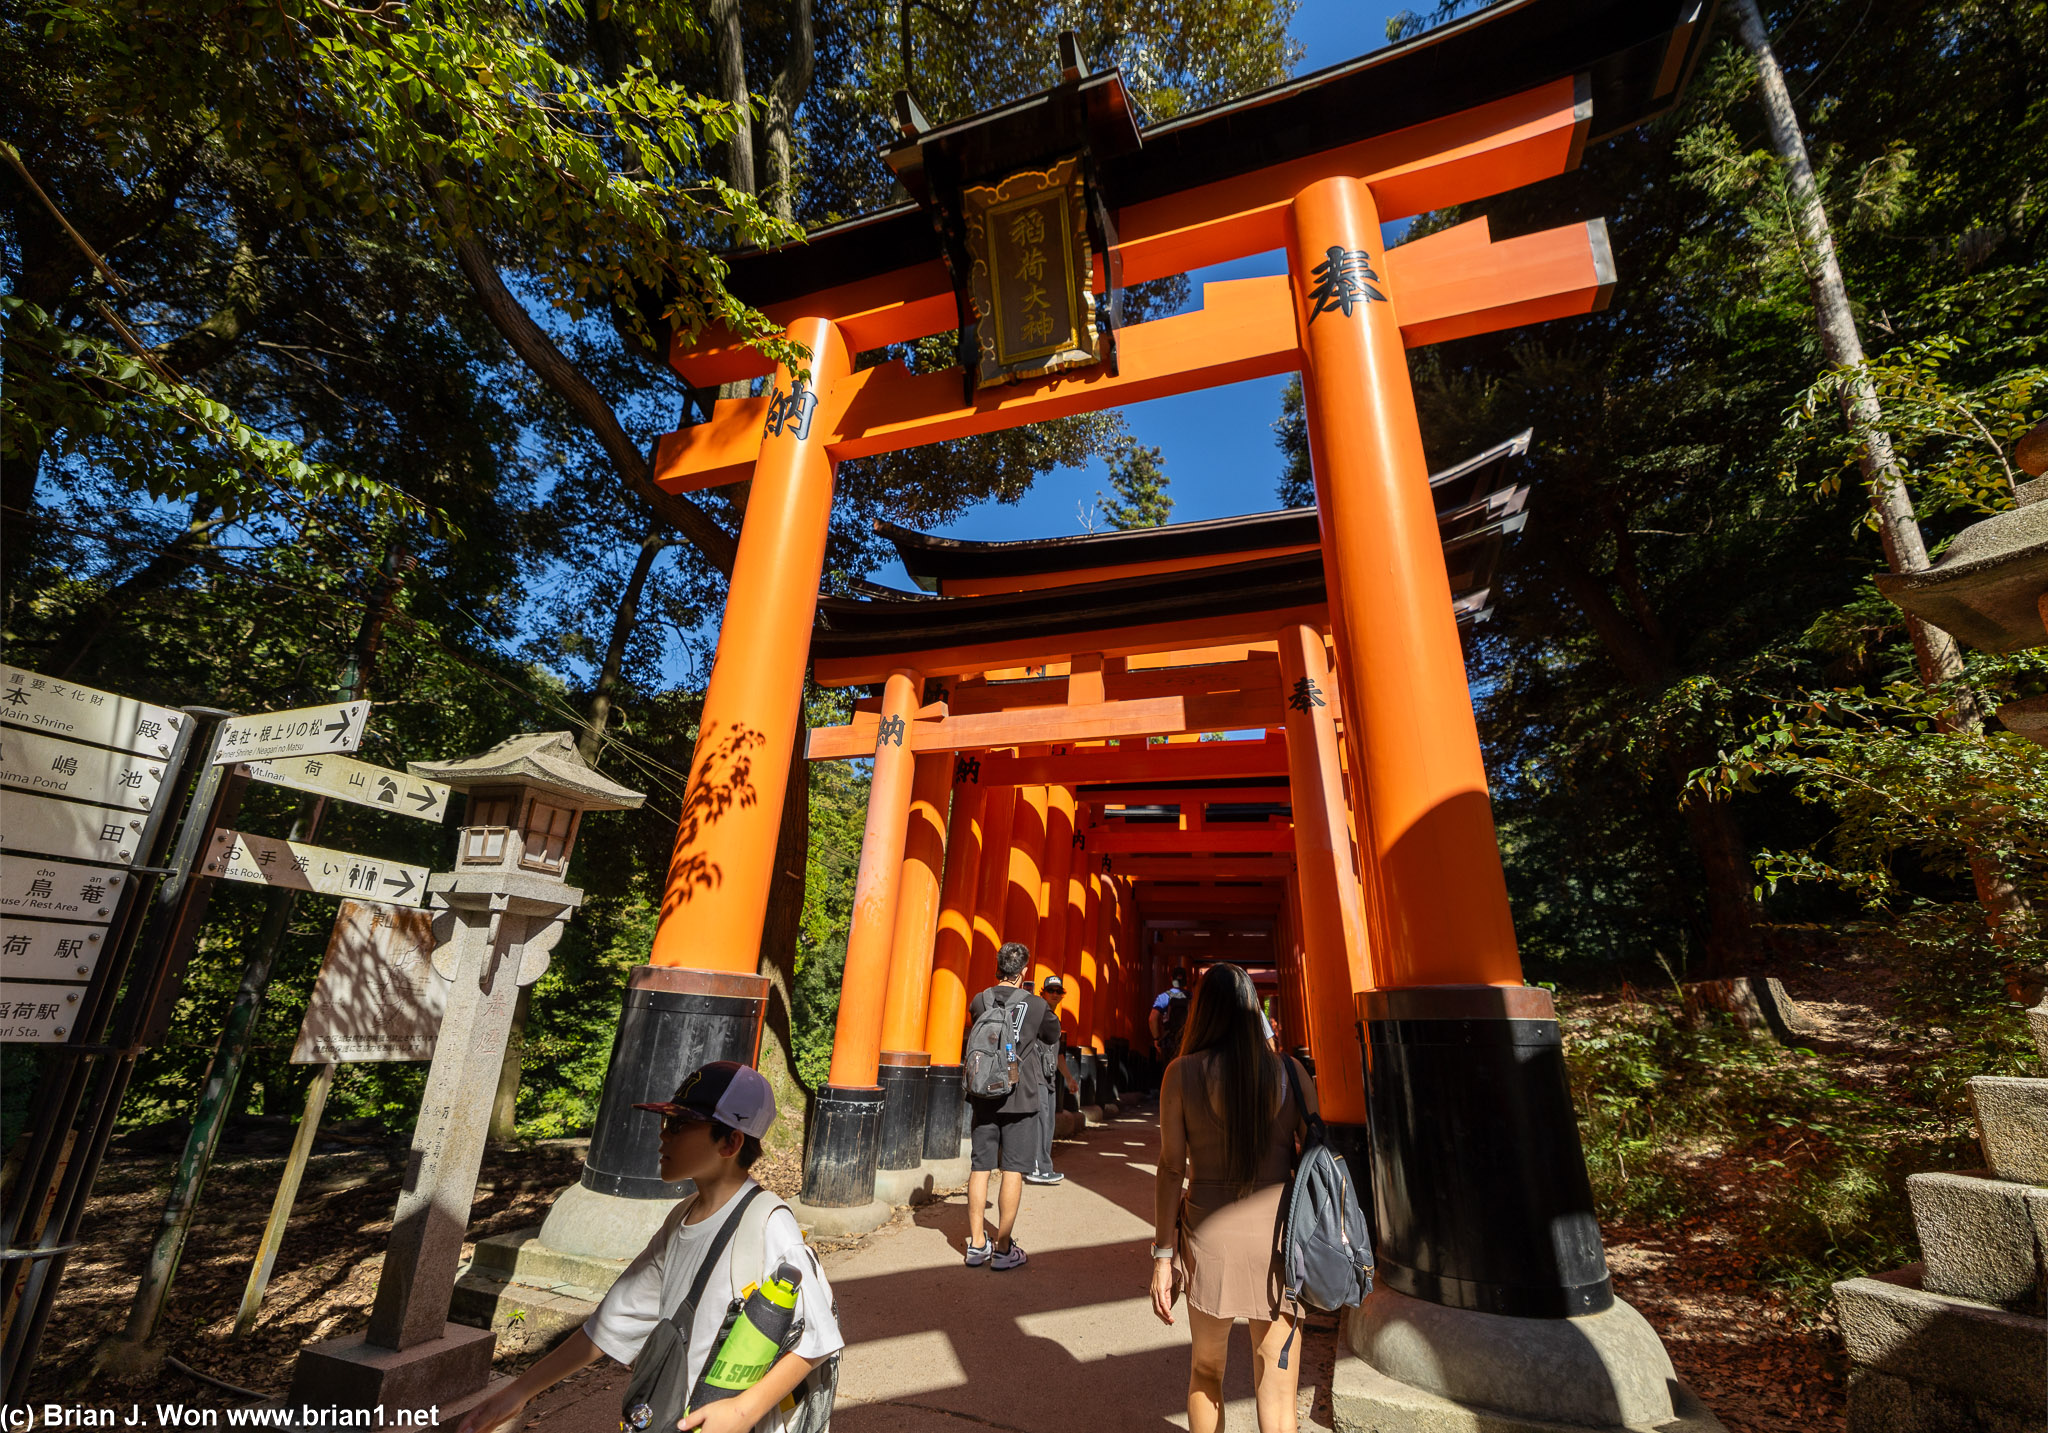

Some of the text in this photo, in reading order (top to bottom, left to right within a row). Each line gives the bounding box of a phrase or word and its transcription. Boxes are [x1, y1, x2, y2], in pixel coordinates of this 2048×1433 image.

[1307, 245, 1388, 328] 奉
[763, 379, 818, 440] 納
[8, 673, 105, 706] 重要文化財
[1287, 676, 1327, 715] 奉
[0, 706, 74, 732] Main Shrine
[876, 714, 906, 747] 納
[225, 718, 323, 747] 奥社・根上りの松
[236, 748, 253, 759] Shrine
[286, 742, 304, 752] Matsu
[955, 755, 981, 784] 納
[33, 775, 69, 791] Pond
[99, 823, 125, 843] 田
[216, 864, 273, 881] Rest Rooms
[222, 843, 339, 876] お手洗い
[37, 868, 102, 884] cho an
[0, 897, 20, 906] use
[30, 899, 53, 909] Rest
[54, 902, 79, 912] Area
[2, 934, 84, 959] 荷駅
[16, 1026, 40, 1037] Sta.
